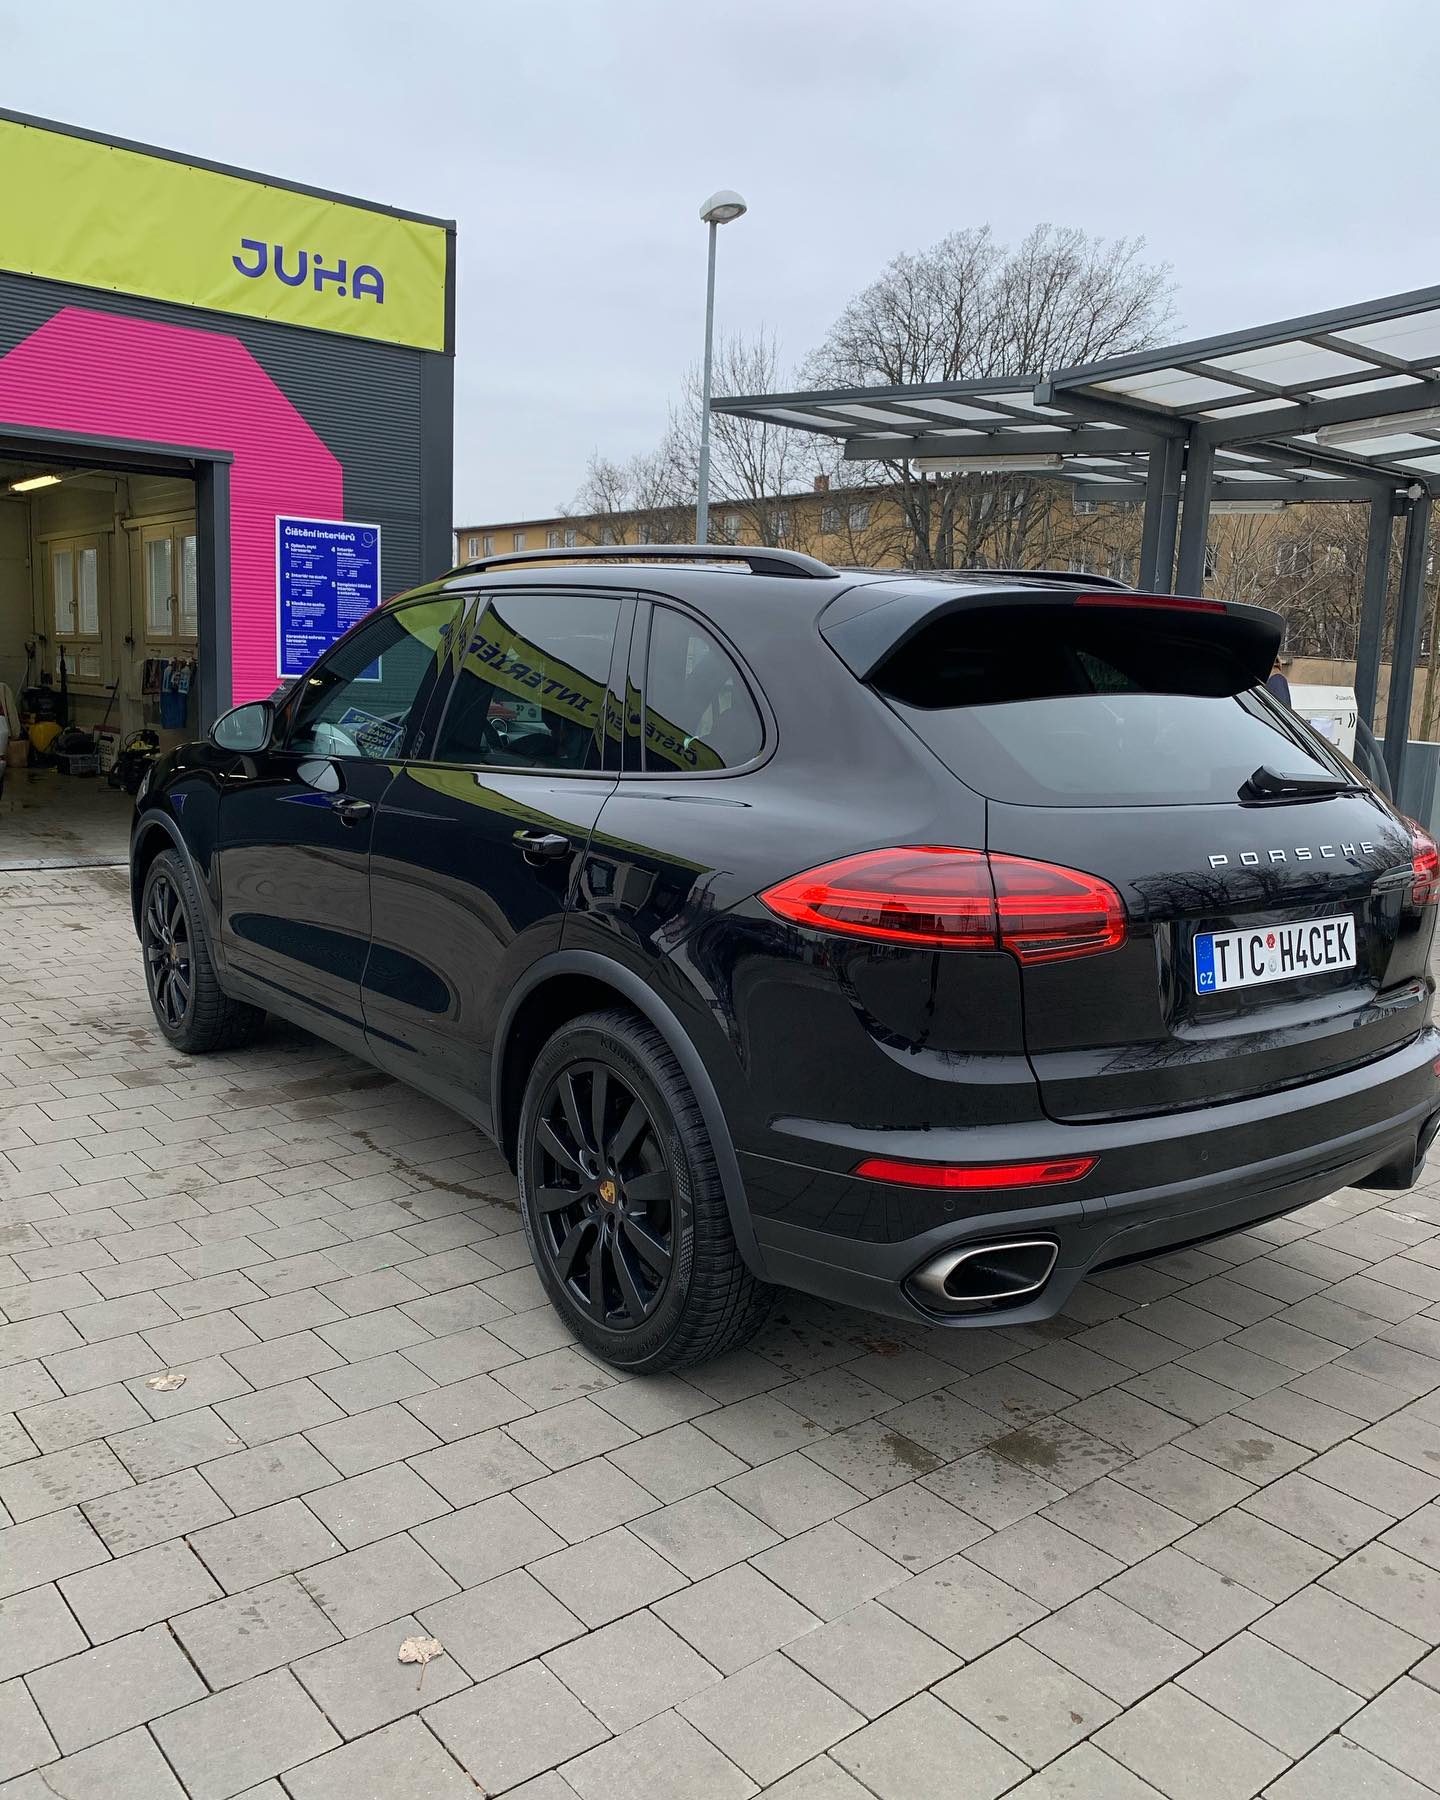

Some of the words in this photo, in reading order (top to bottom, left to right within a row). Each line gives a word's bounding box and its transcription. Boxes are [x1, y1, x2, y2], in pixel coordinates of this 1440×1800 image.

[232, 238, 384, 304] JUHA
[285, 526, 316, 537] Čištění
[317, 530, 355, 541] interiérů
[1208, 841, 1375, 869] PORSCHE
[1215, 935, 1264, 982] TIC
[1279, 921, 1351, 972] H4CEK
[1200, 971, 1213, 986] CZ
